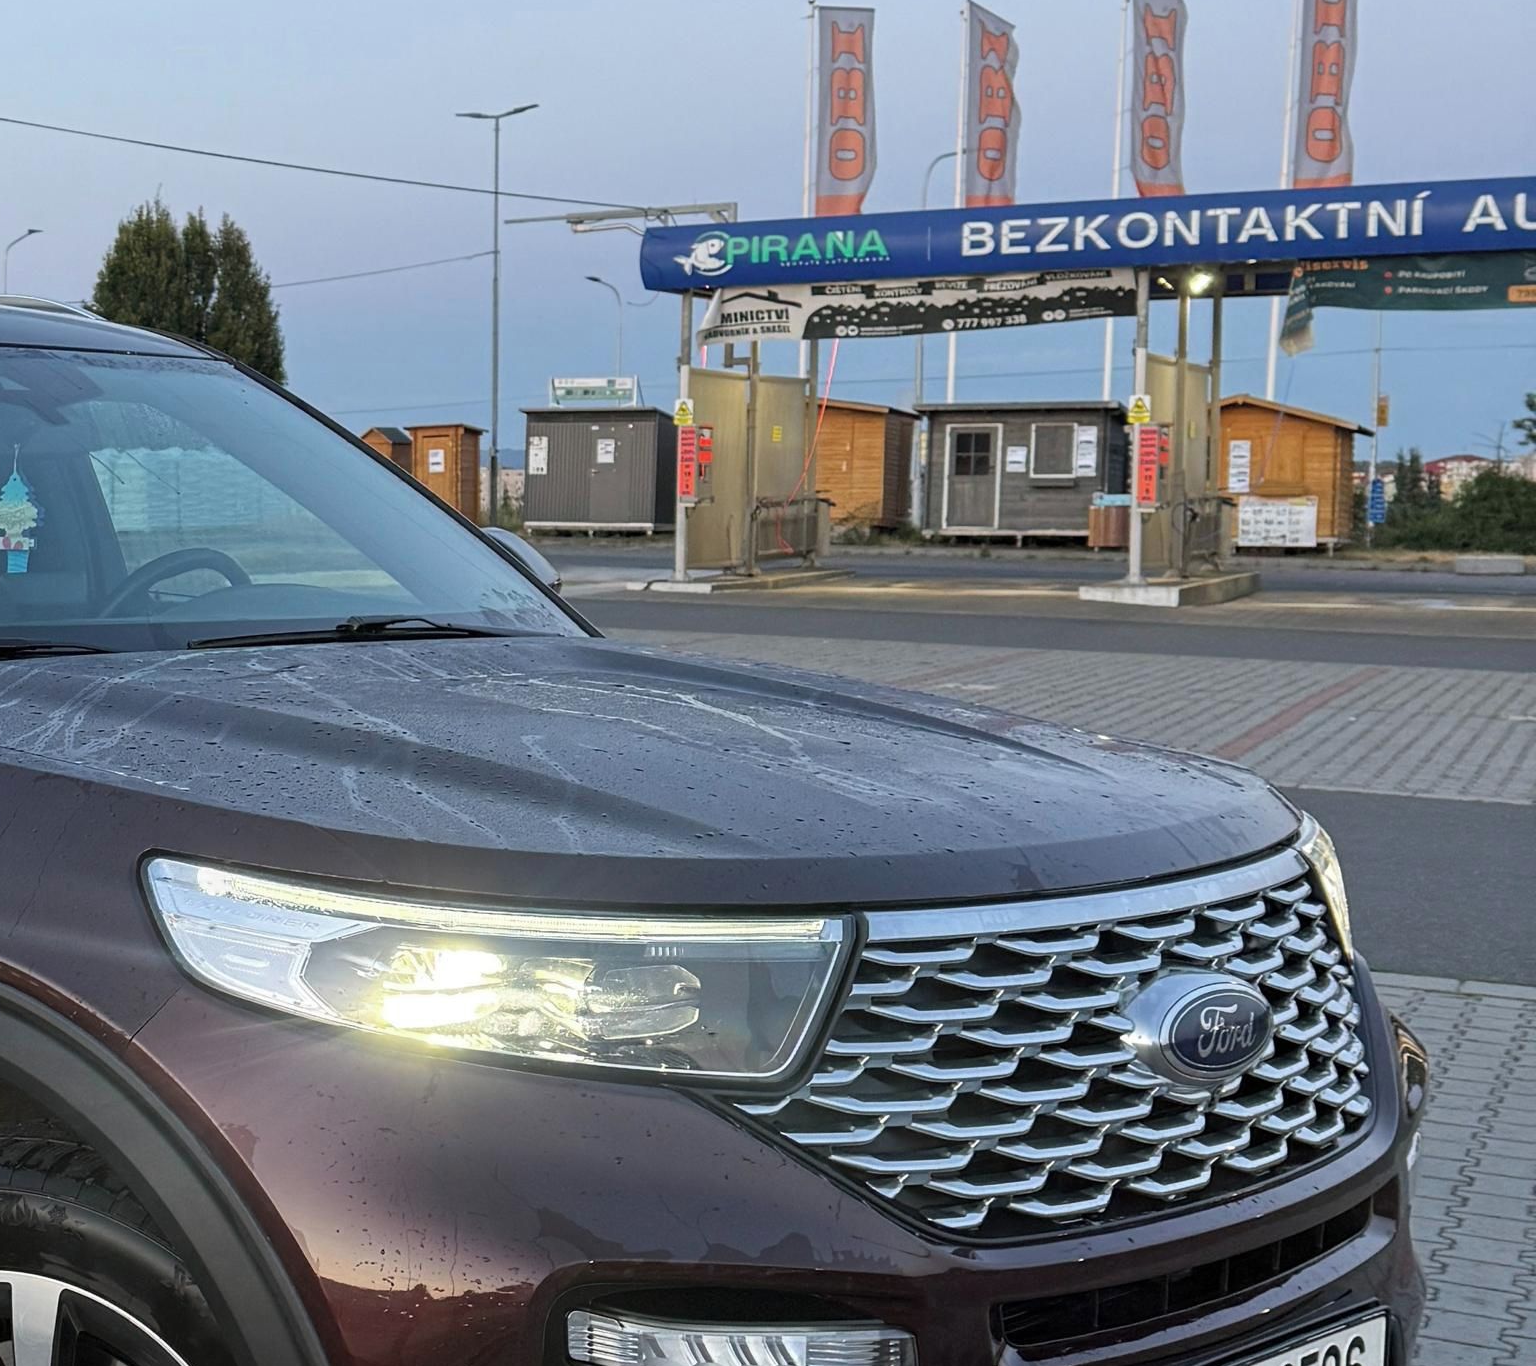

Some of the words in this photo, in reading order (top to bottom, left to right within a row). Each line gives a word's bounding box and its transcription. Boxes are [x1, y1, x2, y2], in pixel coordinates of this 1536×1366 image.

[829, 21, 866, 181] OBI
[977, 20, 1013, 181] OBI
[1141, 3, 1177, 170] OBI
[961, 190, 1432, 257] BEZKONTAKTNÍ
[873, 287, 923, 299] KONTROLY
[1197, 1002, 1257, 1059] Ford
